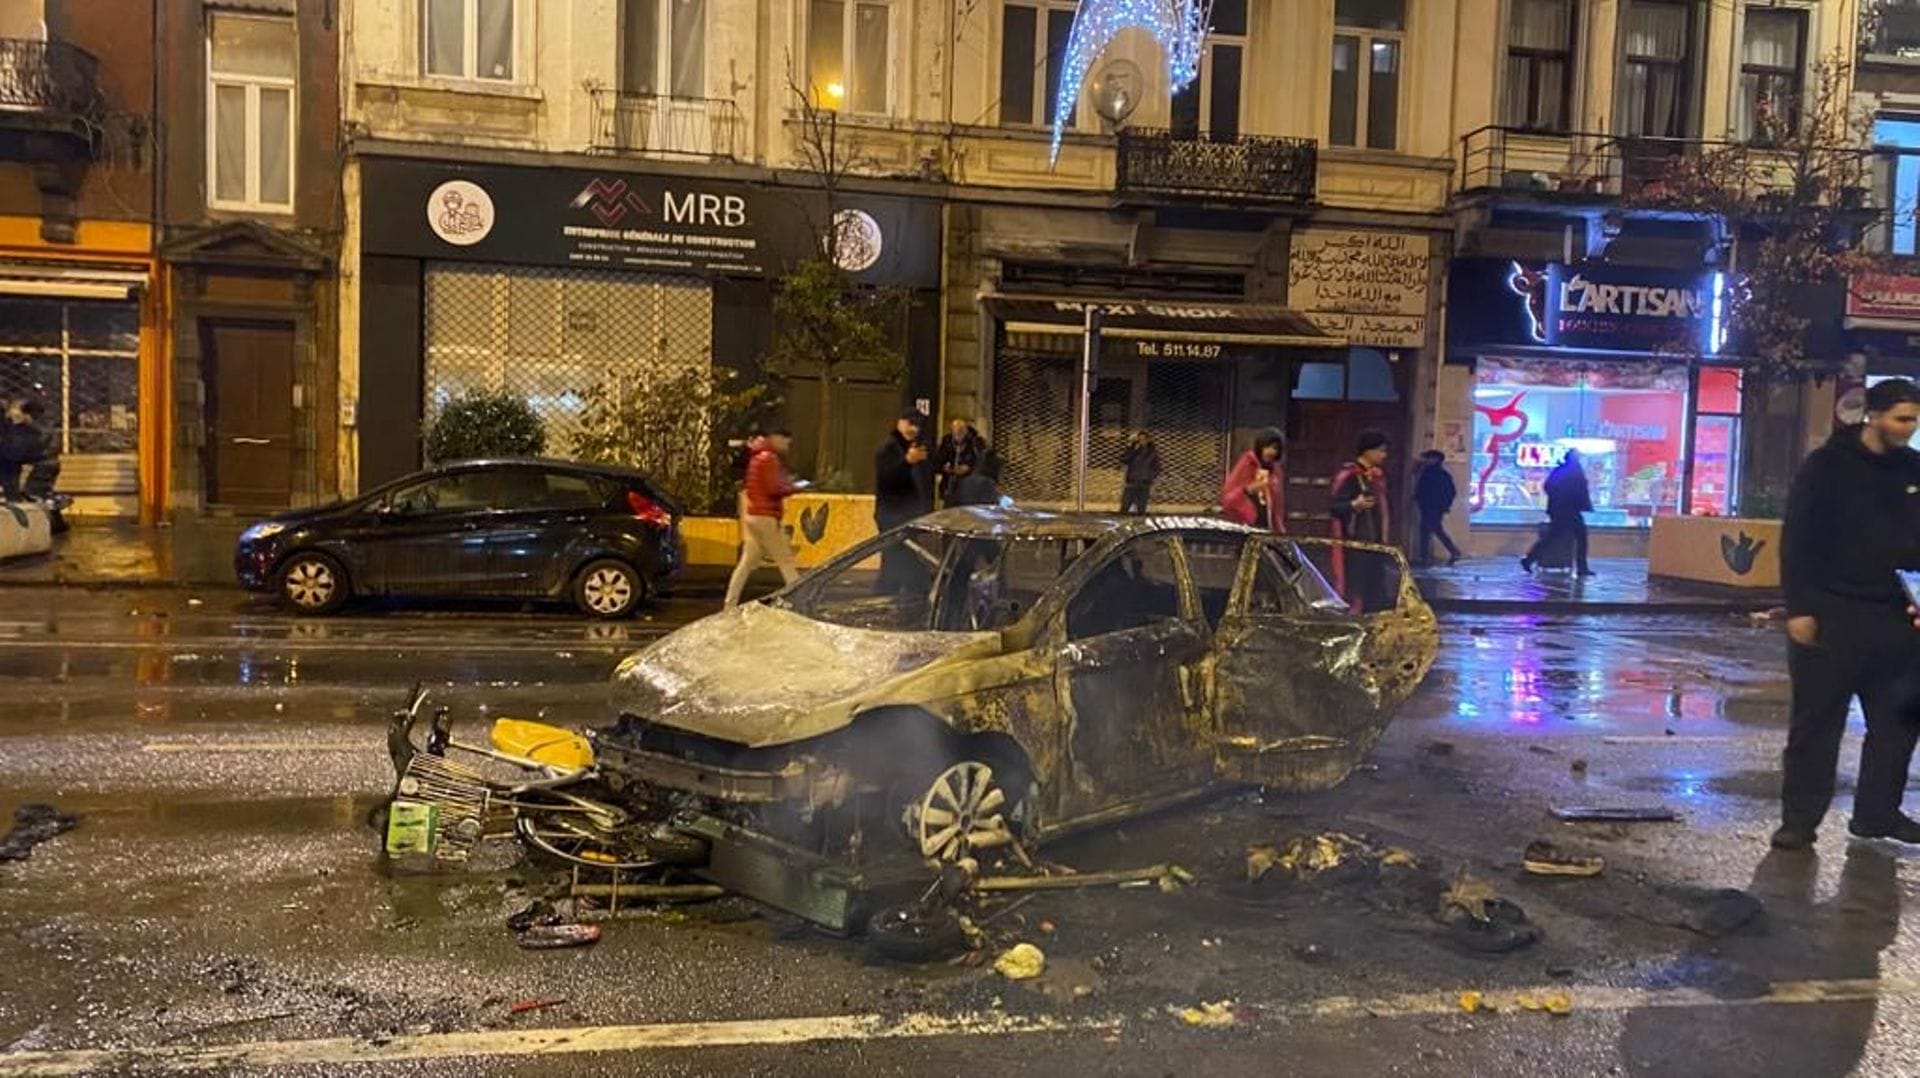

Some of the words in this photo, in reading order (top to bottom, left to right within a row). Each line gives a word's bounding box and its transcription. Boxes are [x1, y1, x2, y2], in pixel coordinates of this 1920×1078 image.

[663, 190, 746, 227] MRB
[623, 229, 670, 243] GÉNÉRALE
[672, 234, 685, 243] DE
[685, 234, 757, 248] CONSTRUCTION
[1147, 305, 1236, 319] CHOIX
[1136, 342, 1159, 355] Tel.
[1162, 343, 1222, 359] 511.14.87
